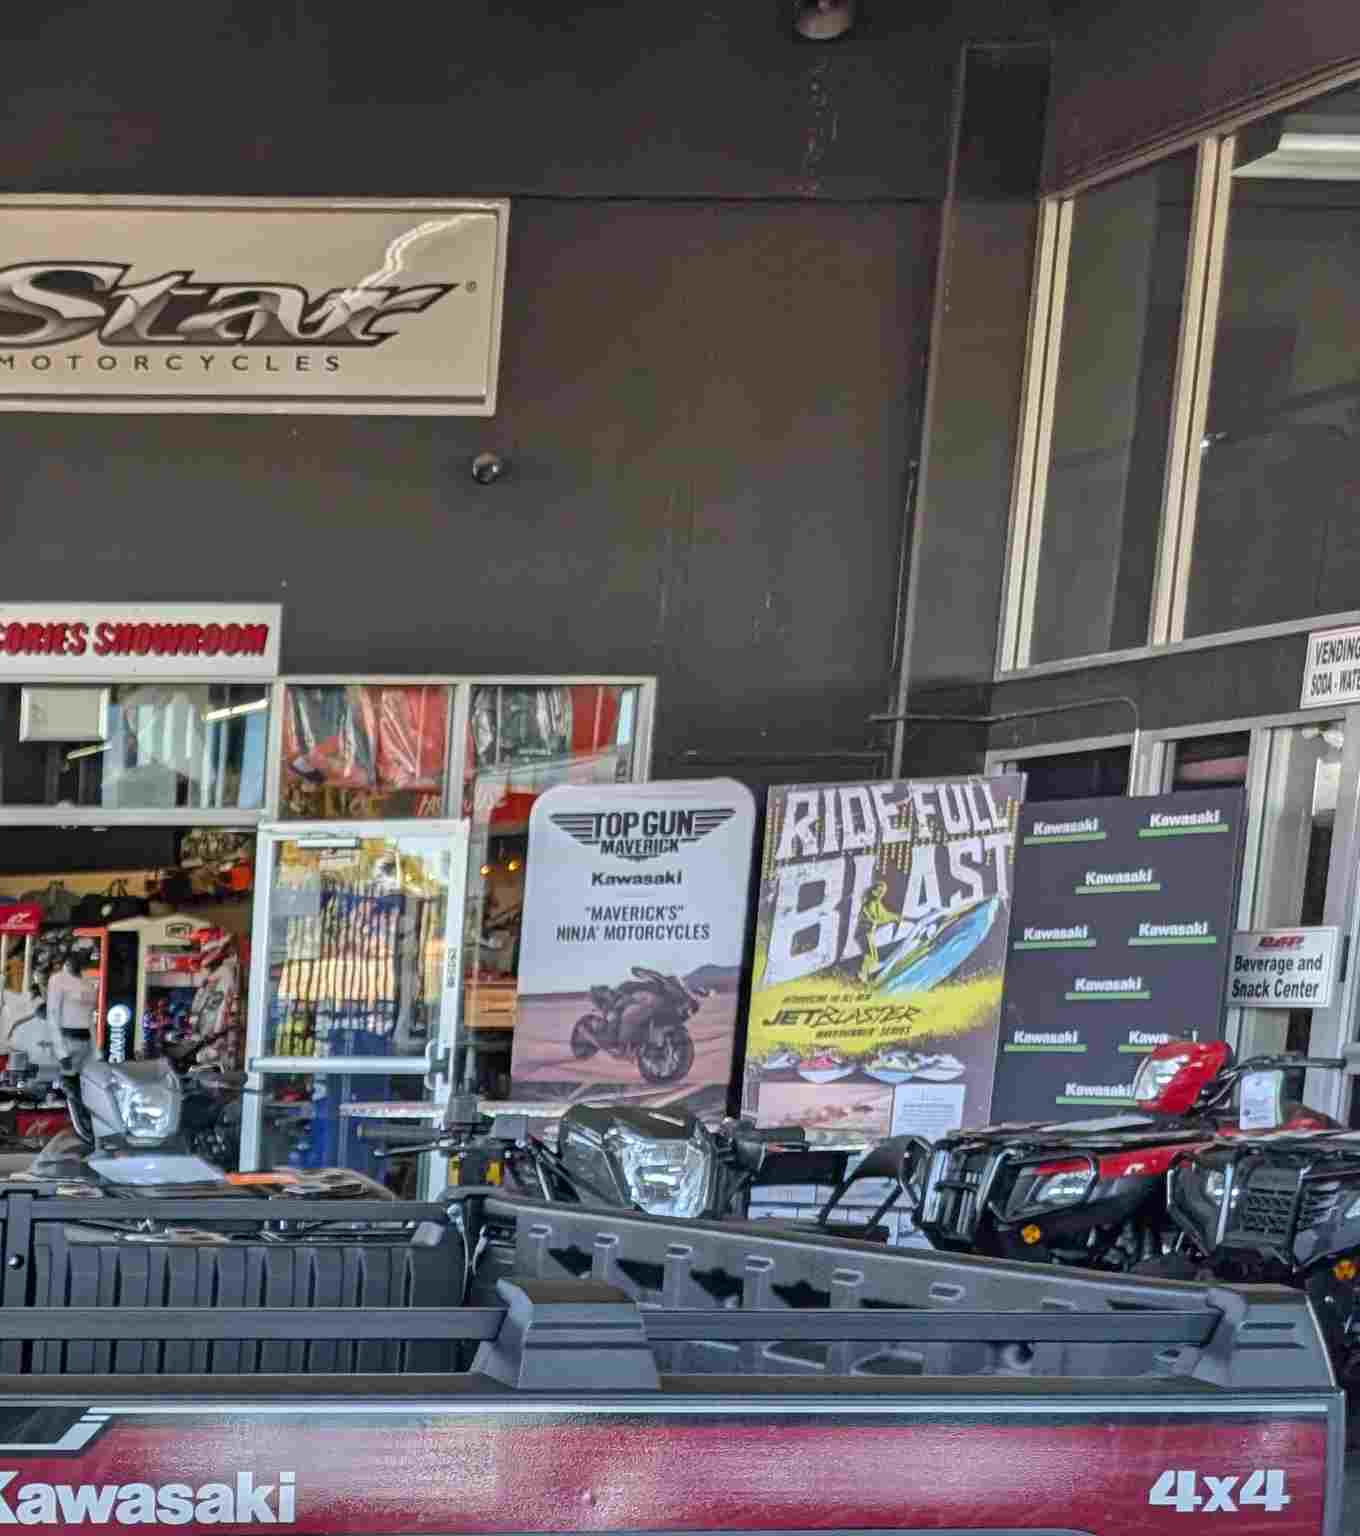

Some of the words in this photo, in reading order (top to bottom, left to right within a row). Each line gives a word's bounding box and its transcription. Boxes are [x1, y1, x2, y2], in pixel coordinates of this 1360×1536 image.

[93, 622, 269, 656] SHOWROOM
[592, 812, 640, 838] TOP
[642, 810, 695, 837] GUN
[776, 785, 912, 860] RIDE
[909, 777, 1010, 845] FULL
[1033, 818, 1098, 835] Kawasaki
[1149, 809, 1221, 828] Kawasaki
[600, 838, 680, 855] MAVERICK
[591, 870, 683, 886] Kawasaki
[1085, 868, 1153, 885] Kawasaki
[764, 832, 1014, 985] BLAST
[603, 923, 711, 941] MOTORCYCLES
[1024, 925, 1088, 940] Kawasaki
[1139, 921, 1208, 936] Kawasaki
[1233, 955, 1294, 976] Beverage
[1298, 952, 1323, 972] and
[1075, 977, 1142, 991] Kawasaki
[1231, 978, 1270, 998] Snack
[1274, 979, 1320, 999] Center
[1014, 1030, 1078, 1044] Kawasaki
[1148, 1469, 1291, 1513] 4x4
